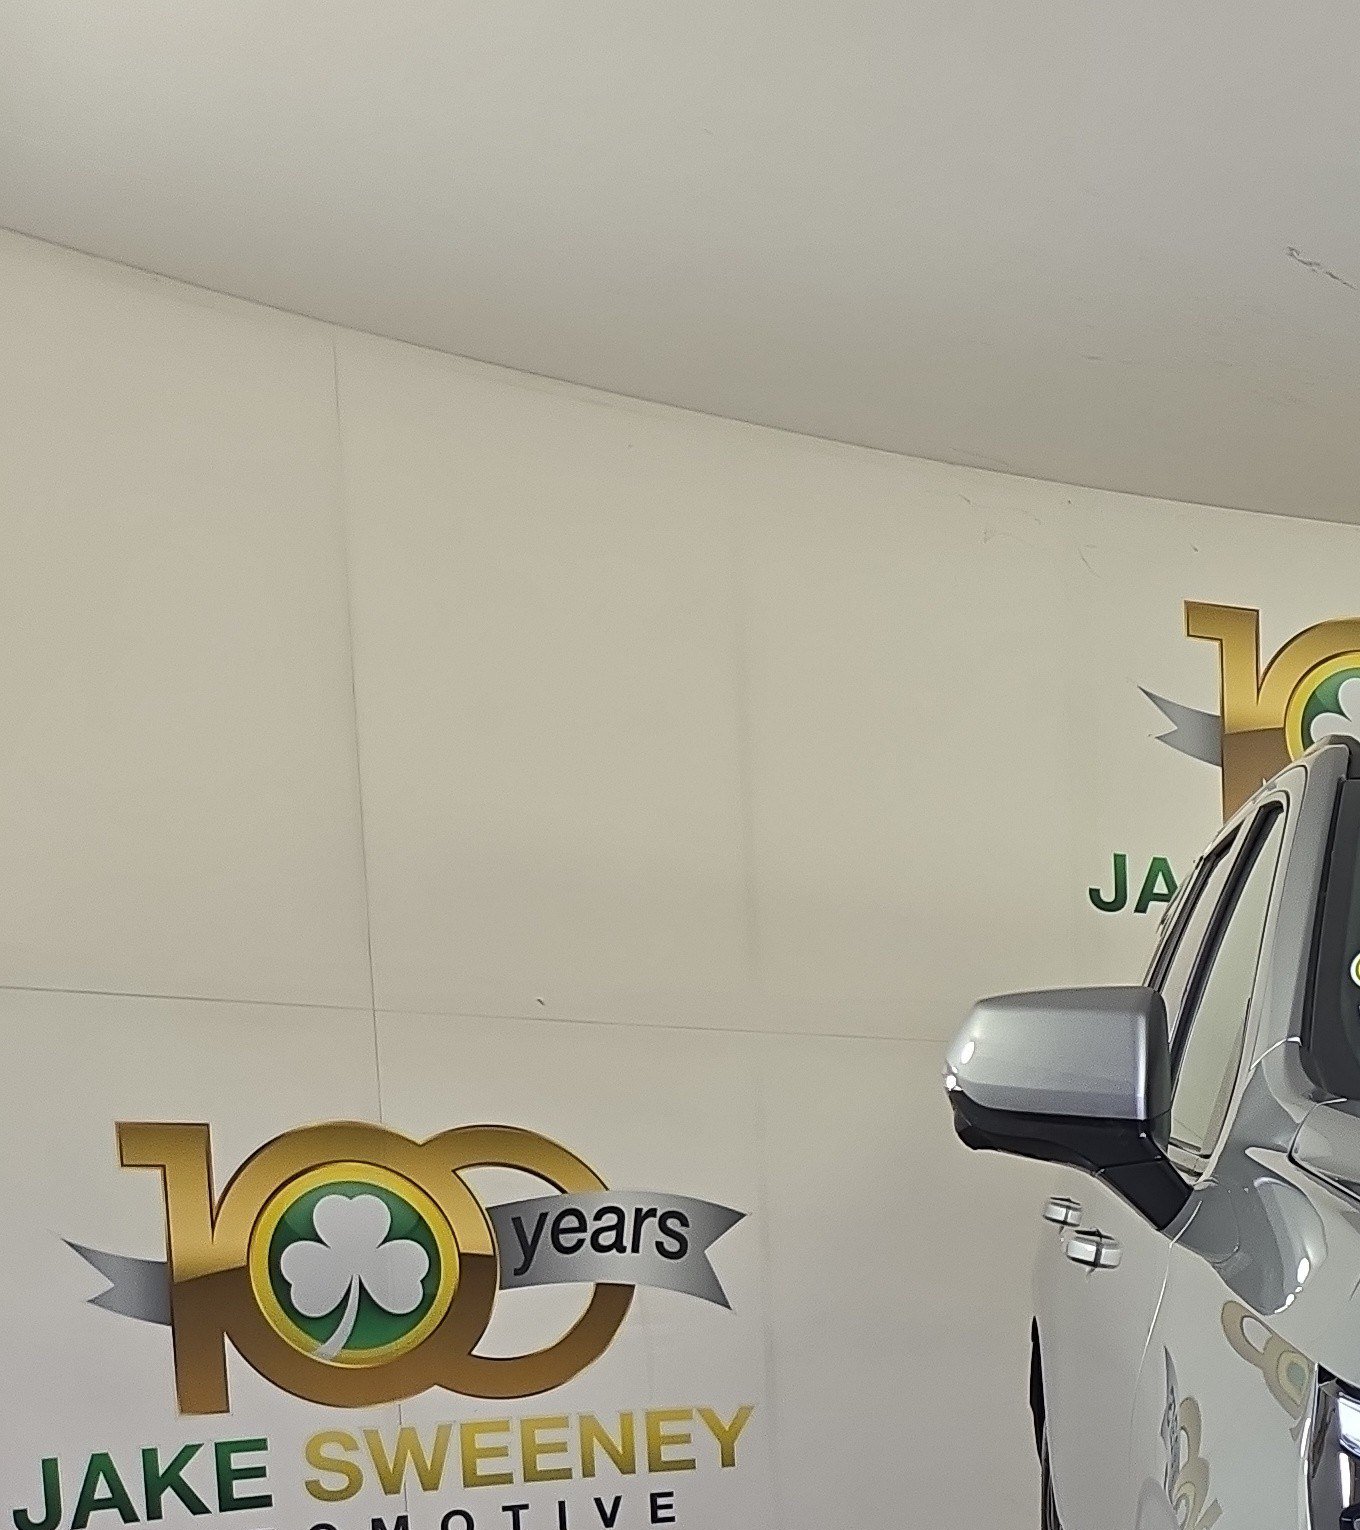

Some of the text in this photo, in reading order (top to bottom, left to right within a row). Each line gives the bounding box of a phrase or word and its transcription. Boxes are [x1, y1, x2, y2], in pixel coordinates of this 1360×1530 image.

[1088, 853, 1179, 914] JA
[511, 1203, 690, 1276] years
[303, 1406, 755, 1503] SWEENEY
